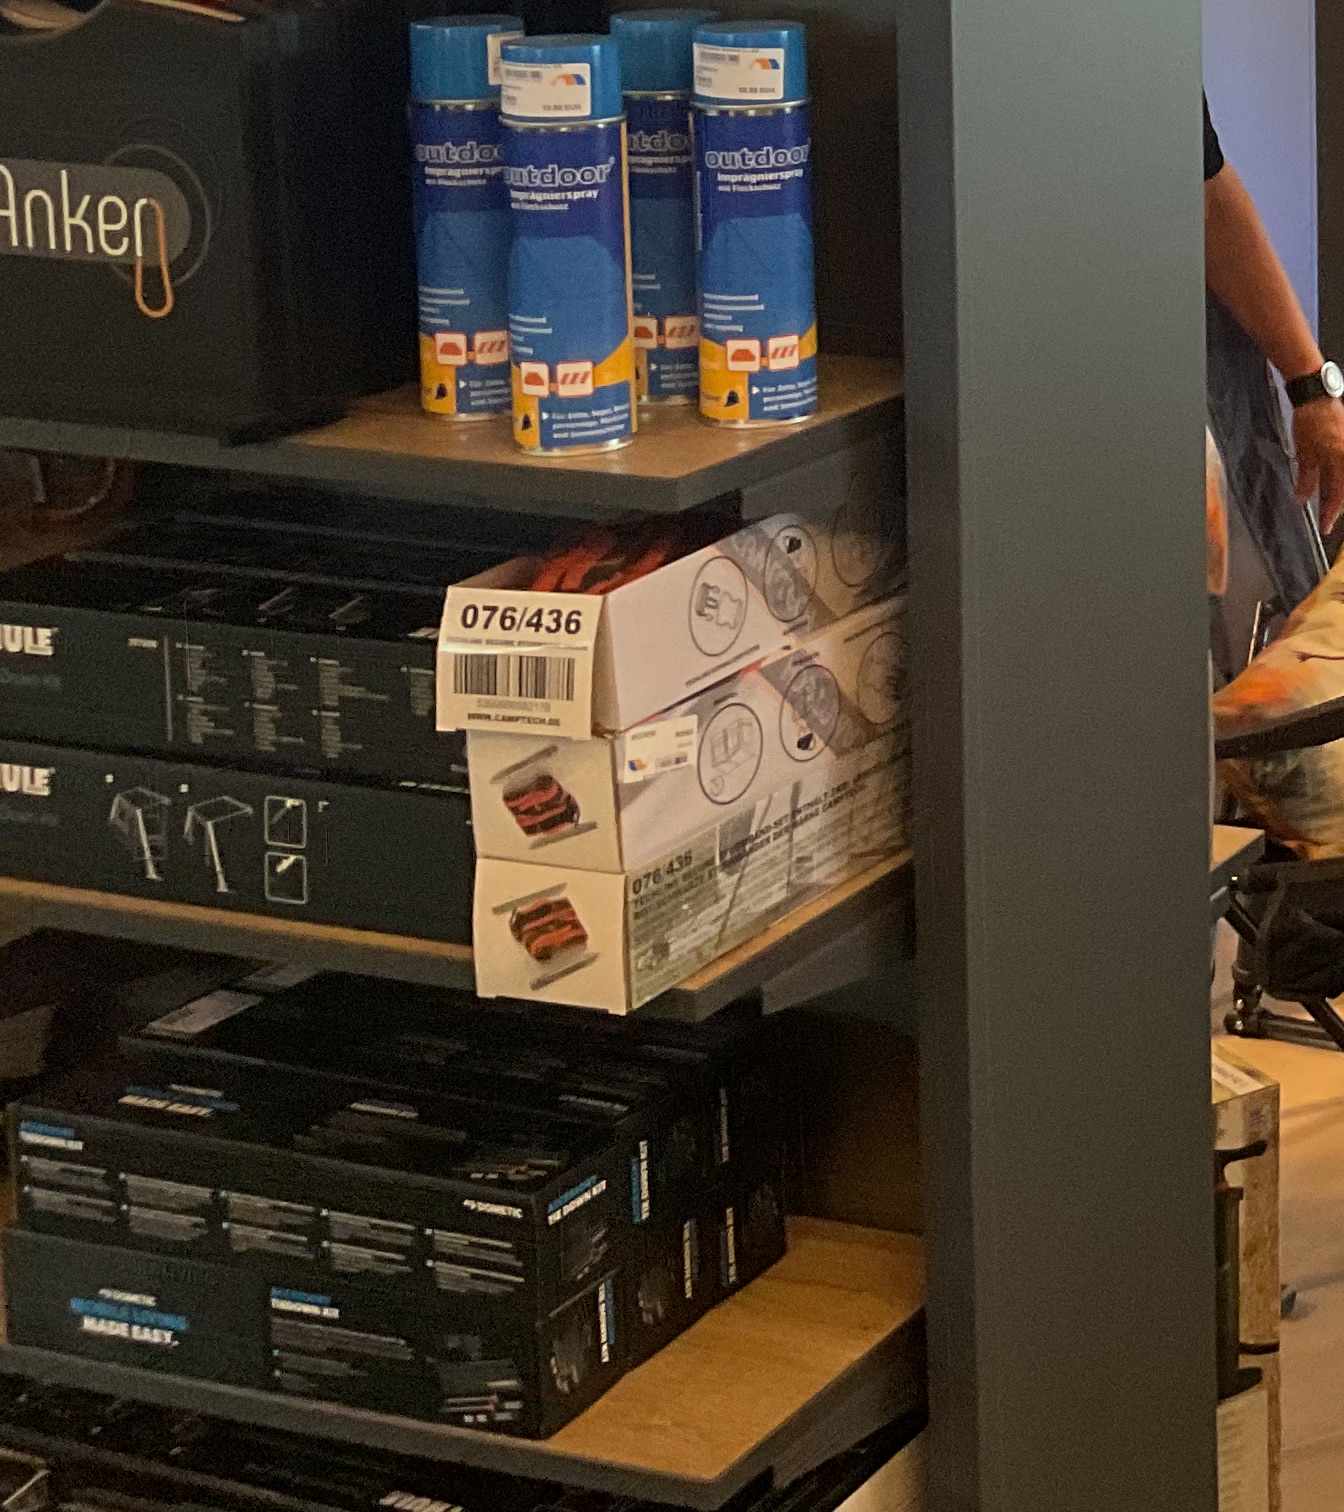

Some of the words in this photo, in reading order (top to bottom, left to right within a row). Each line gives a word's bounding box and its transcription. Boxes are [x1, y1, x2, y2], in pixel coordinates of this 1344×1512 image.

[415, 141, 501, 164] outdo
[705, 146, 809, 170] outdoor
[502, 164, 612, 187] outdoor
[461, 603, 583, 635] 076/436
[0, 623, 53, 655] ULE
[0, 764, 50, 796] ULE
